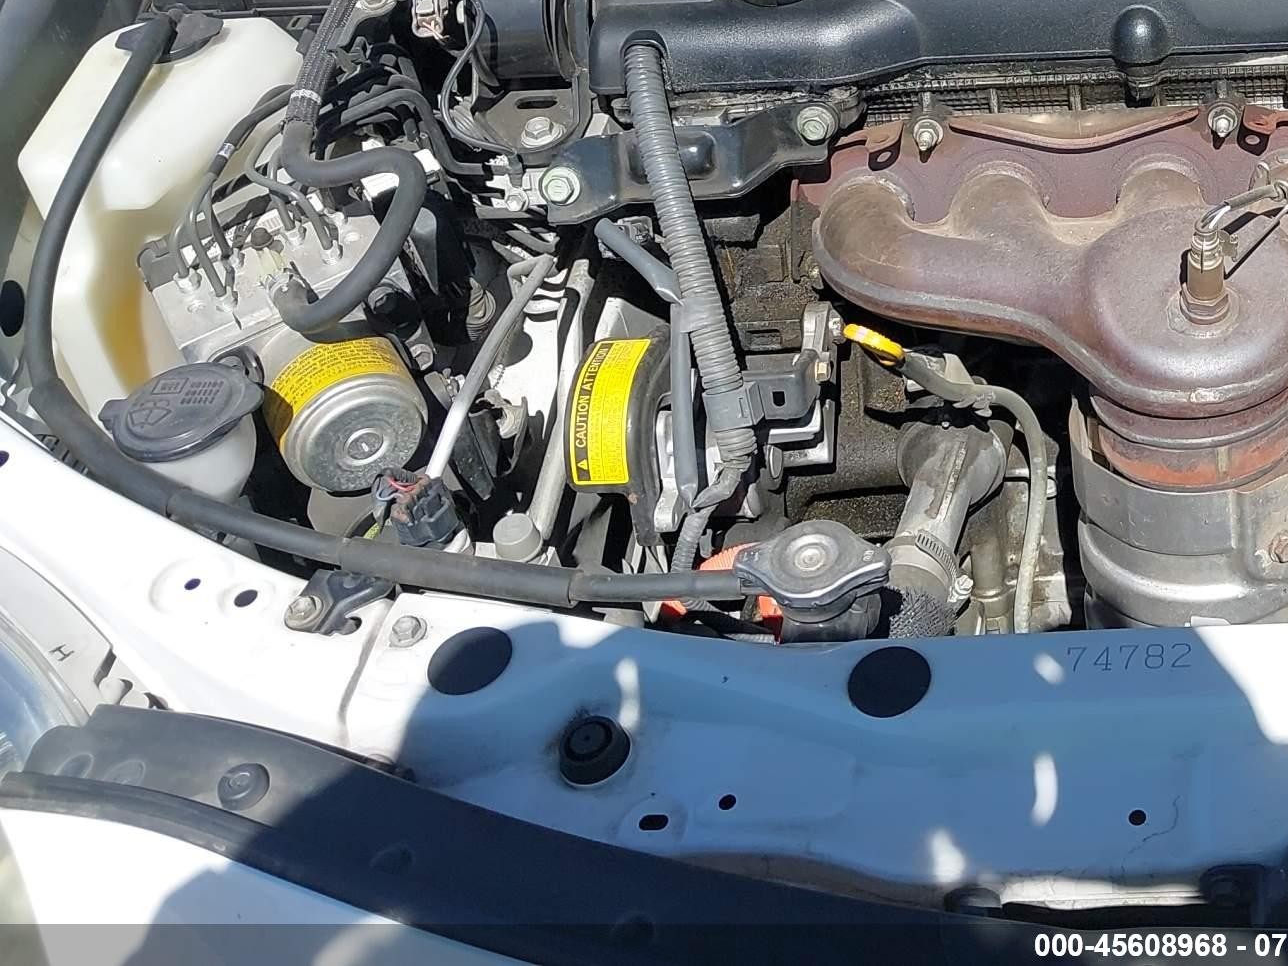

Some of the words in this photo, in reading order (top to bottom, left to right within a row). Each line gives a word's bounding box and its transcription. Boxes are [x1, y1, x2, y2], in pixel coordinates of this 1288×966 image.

[576, 395, 590, 448] CAUTION
[584, 347, 609, 391] ATTENTION
[1066, 642, 1193, 672] 74782
